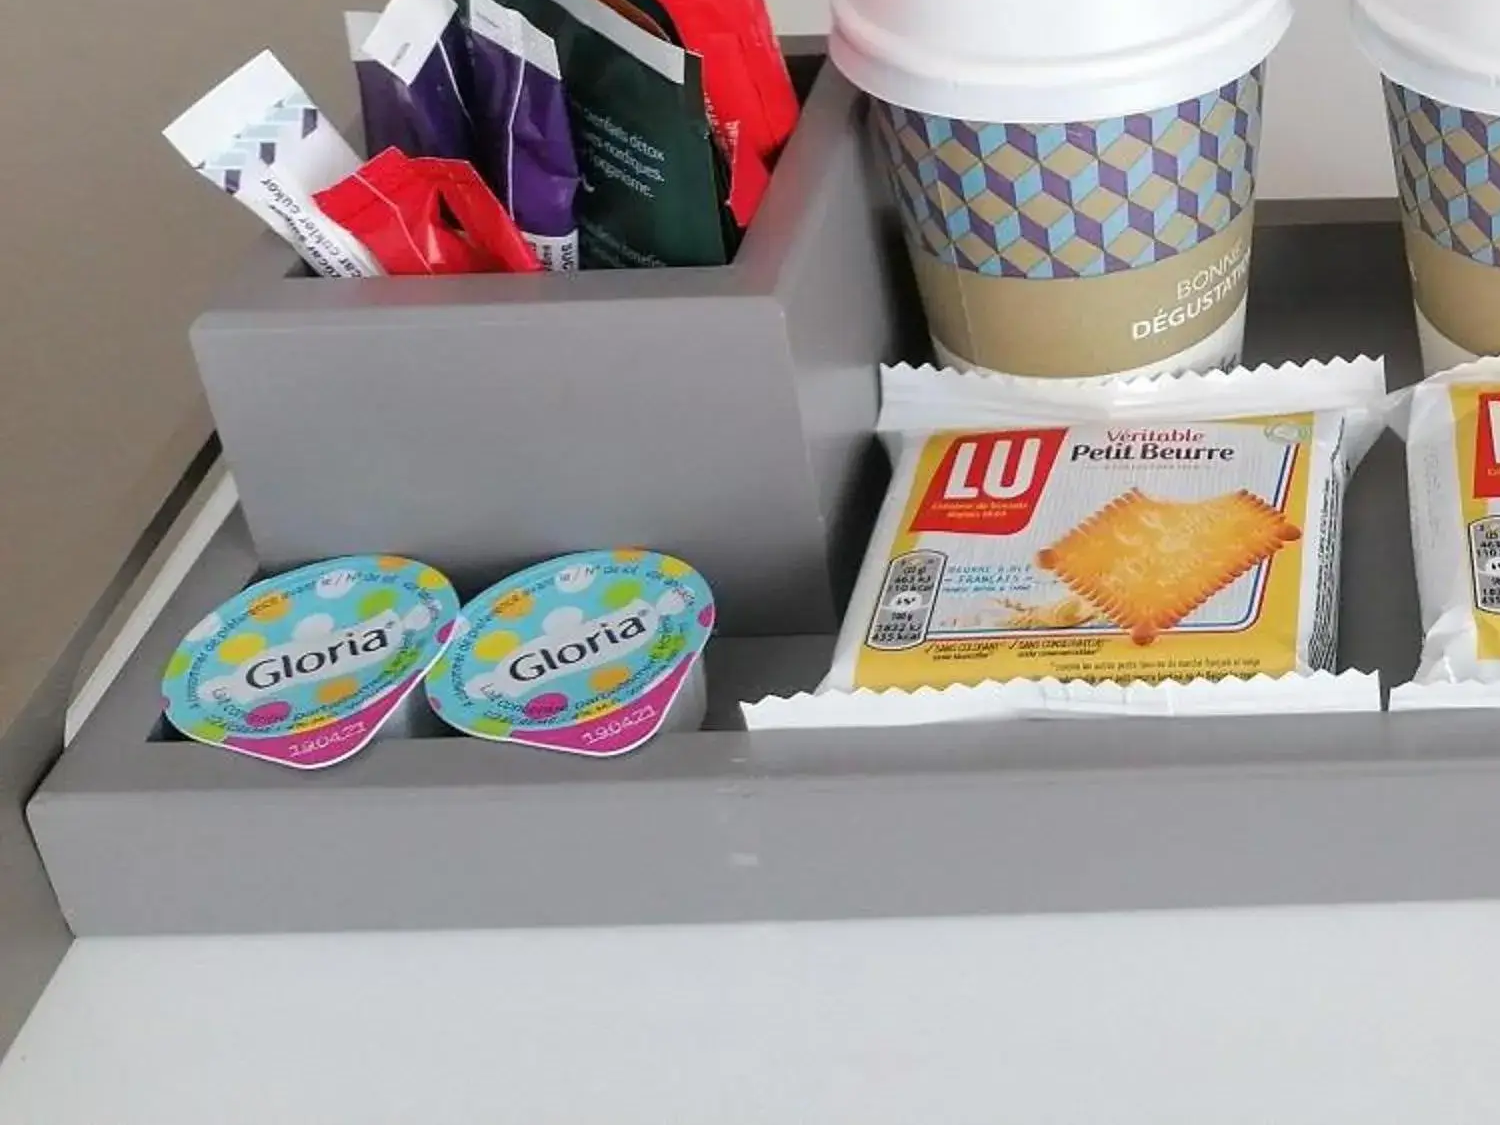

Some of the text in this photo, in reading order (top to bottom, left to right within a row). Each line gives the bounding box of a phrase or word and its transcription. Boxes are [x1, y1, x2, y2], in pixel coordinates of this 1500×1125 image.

[1131, 247, 1250, 341] DÉGUSTATI
[1071, 444, 1235, 462] Petit Beurre
[1106, 427, 1205, 443] Véritable
[943, 438, 1041, 500] LU
[246, 627, 389, 691] Gloria
[509, 614, 648, 682] Gloria
[582, 705, 658, 746] 190421
